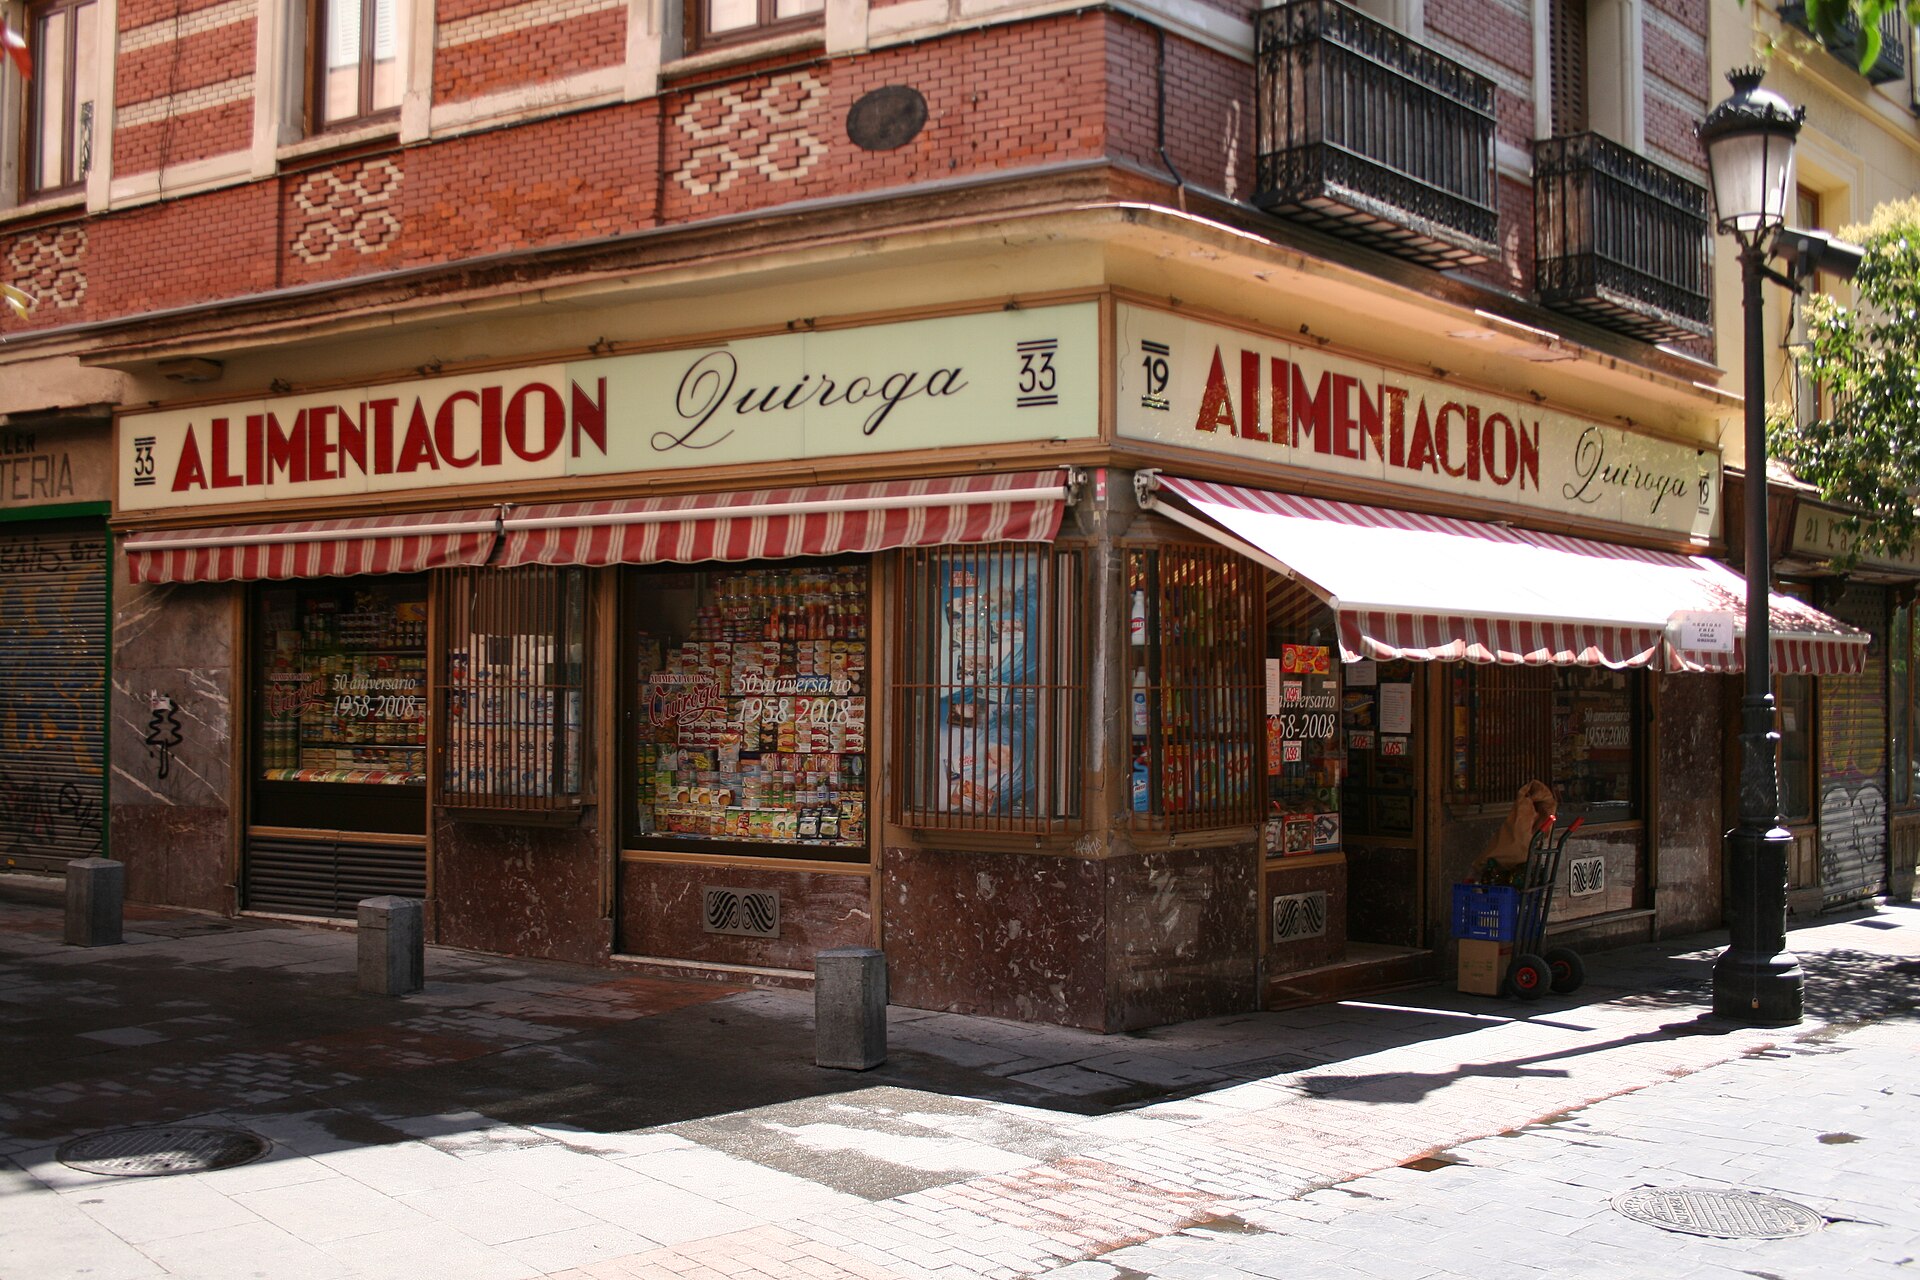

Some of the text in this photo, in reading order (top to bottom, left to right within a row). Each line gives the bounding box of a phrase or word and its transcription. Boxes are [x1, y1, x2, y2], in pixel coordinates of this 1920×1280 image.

[1019, 351, 1057, 393] 33
[1142, 354, 1170, 396] 19
[650, 350, 969, 452] Quiroga
[1195, 343, 1540, 493] ALIMENTACION
[0, 432, 36, 456] LER
[171, 376, 607, 492] ALIMENTACION
[134, 446, 155, 476] 33
[1562, 424, 1688, 513] Quiroga
[1698, 478, 1710, 505] 19
[1804, 516, 1819, 543] 21
[332, 673, 416, 691] 50 aniversario
[736, 673, 851, 693] 50 aniversario
[332, 695, 416, 717] 1958-2008
[649, 681, 727, 728] Quiroga
[1583, 726, 1630, 747] 1958-2008
